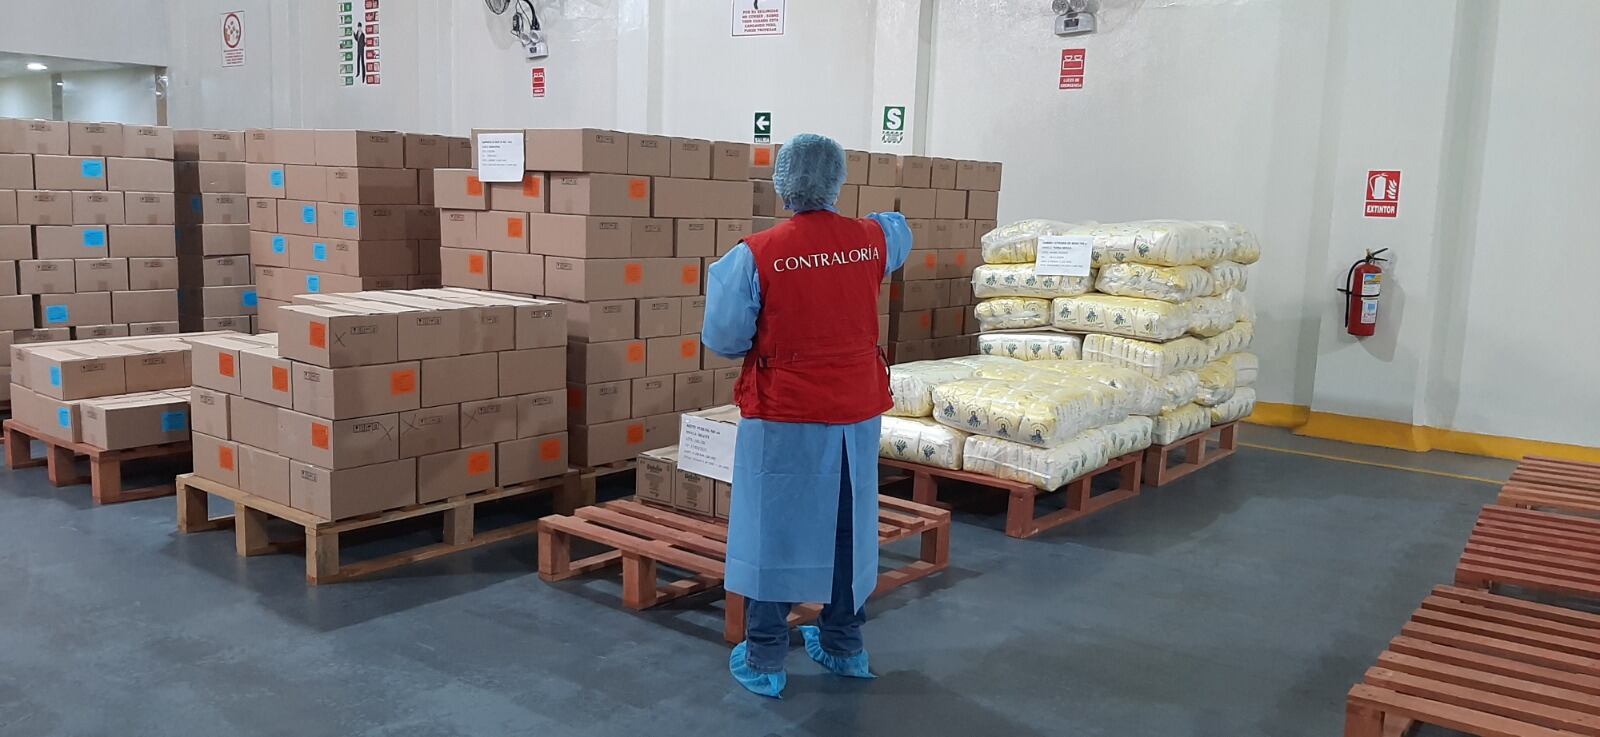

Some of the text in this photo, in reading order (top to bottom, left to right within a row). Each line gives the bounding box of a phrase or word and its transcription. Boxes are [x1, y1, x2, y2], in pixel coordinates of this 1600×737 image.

[886, 107, 902, 130] S
[1366, 205, 1396, 214] EXTINTOR
[773, 243, 880, 272] CONTRALORÍA
